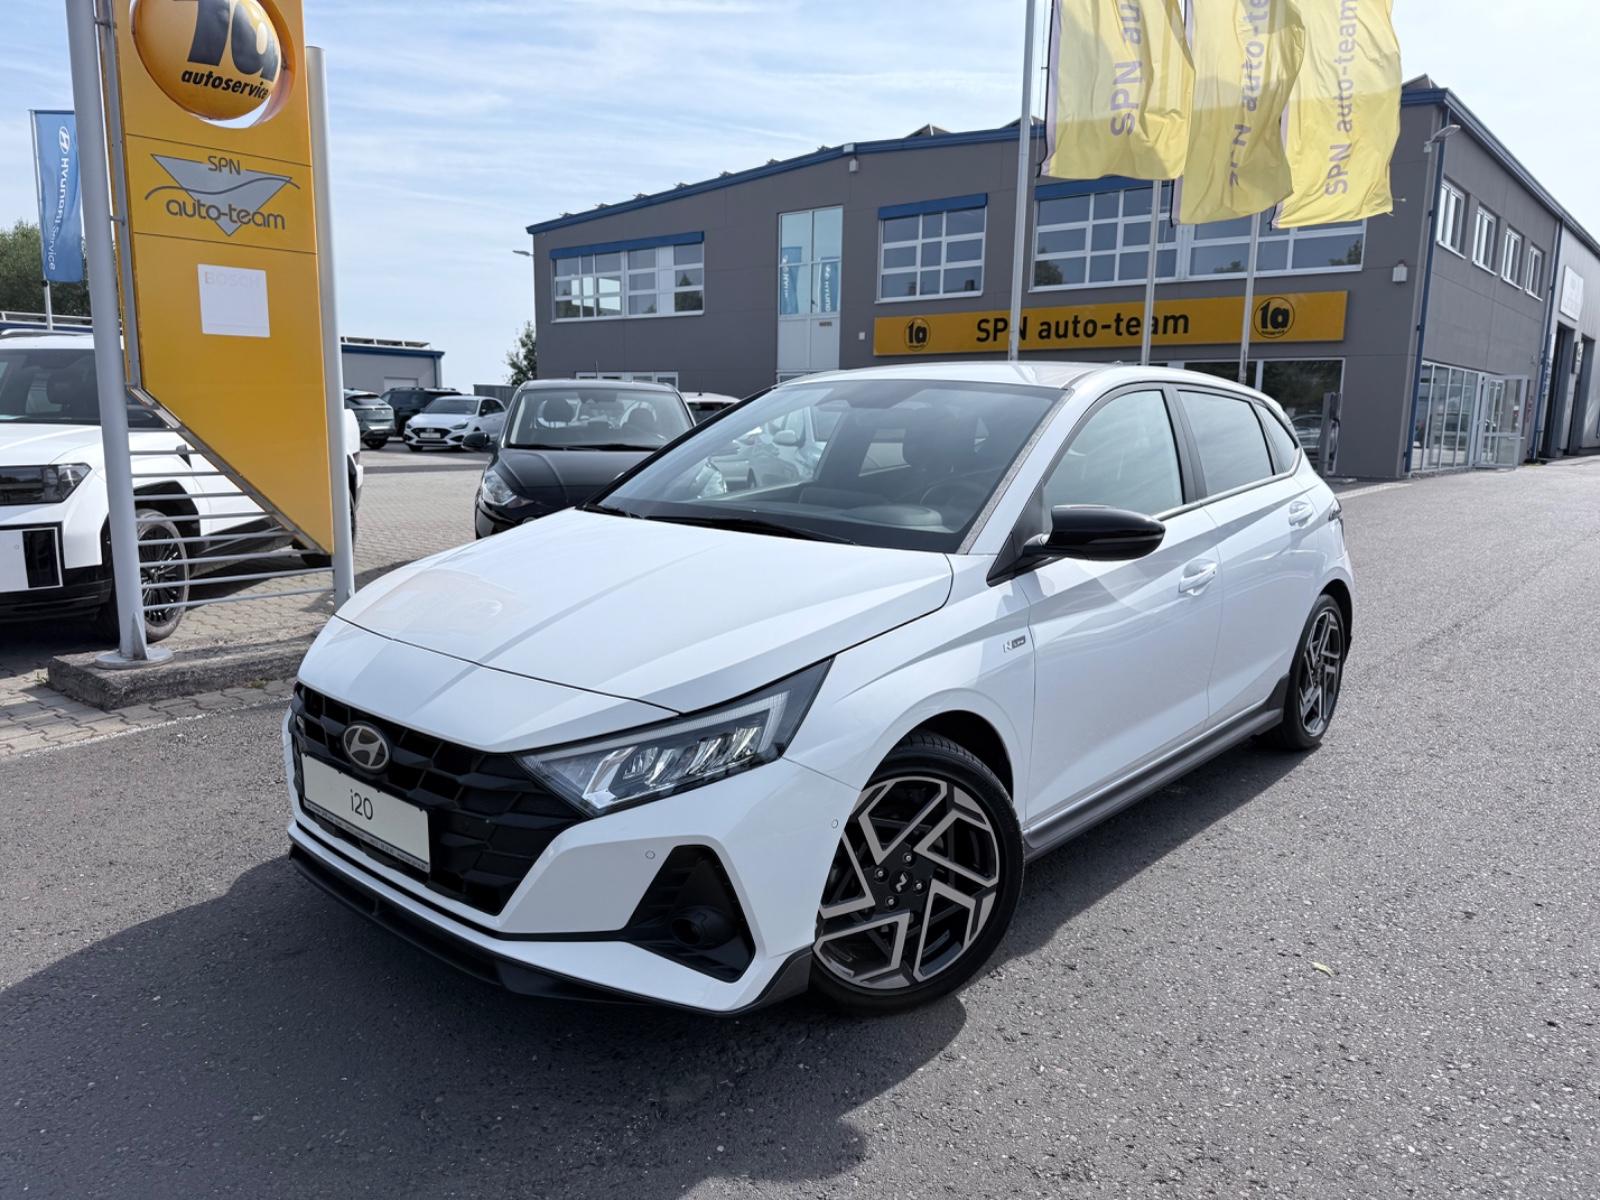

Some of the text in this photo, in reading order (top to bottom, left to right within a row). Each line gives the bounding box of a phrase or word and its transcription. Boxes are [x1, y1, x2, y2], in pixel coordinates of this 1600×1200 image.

[181, 70, 270, 100] autoservice
[1110, 61, 1143, 136] SPN
[1324, 0, 1358, 196] SPN auto-team
[207, 155, 241, 176] SPN
[166, 199, 286, 231] auto-team
[1038, 312, 1190, 341] auto-team
[350, 788, 374, 821] i20
